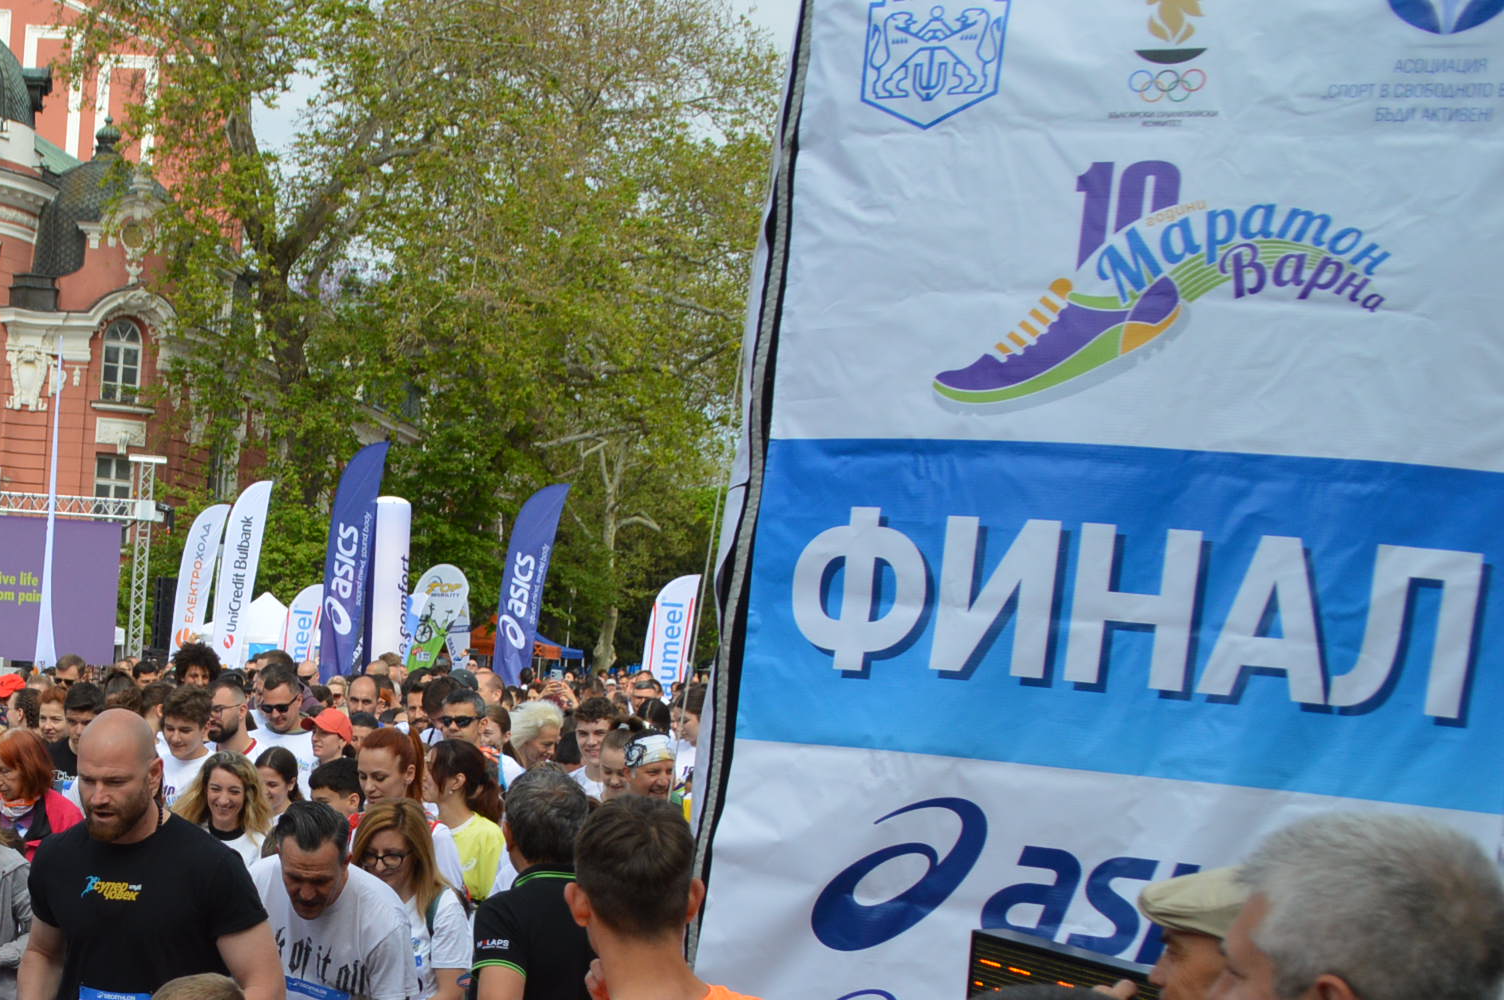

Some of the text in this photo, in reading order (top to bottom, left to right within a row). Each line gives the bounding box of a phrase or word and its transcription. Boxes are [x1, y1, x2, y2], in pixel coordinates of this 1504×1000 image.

[1075, 160, 1182, 272] 10
[1097, 203, 1392, 304] Маратон
[1219, 243, 1386, 314] Варна
[19, 571, 40, 587] life
[226, 515, 254, 632] UniCredit Bulbank
[792, 507, 1492, 728] ФИНАЛ
